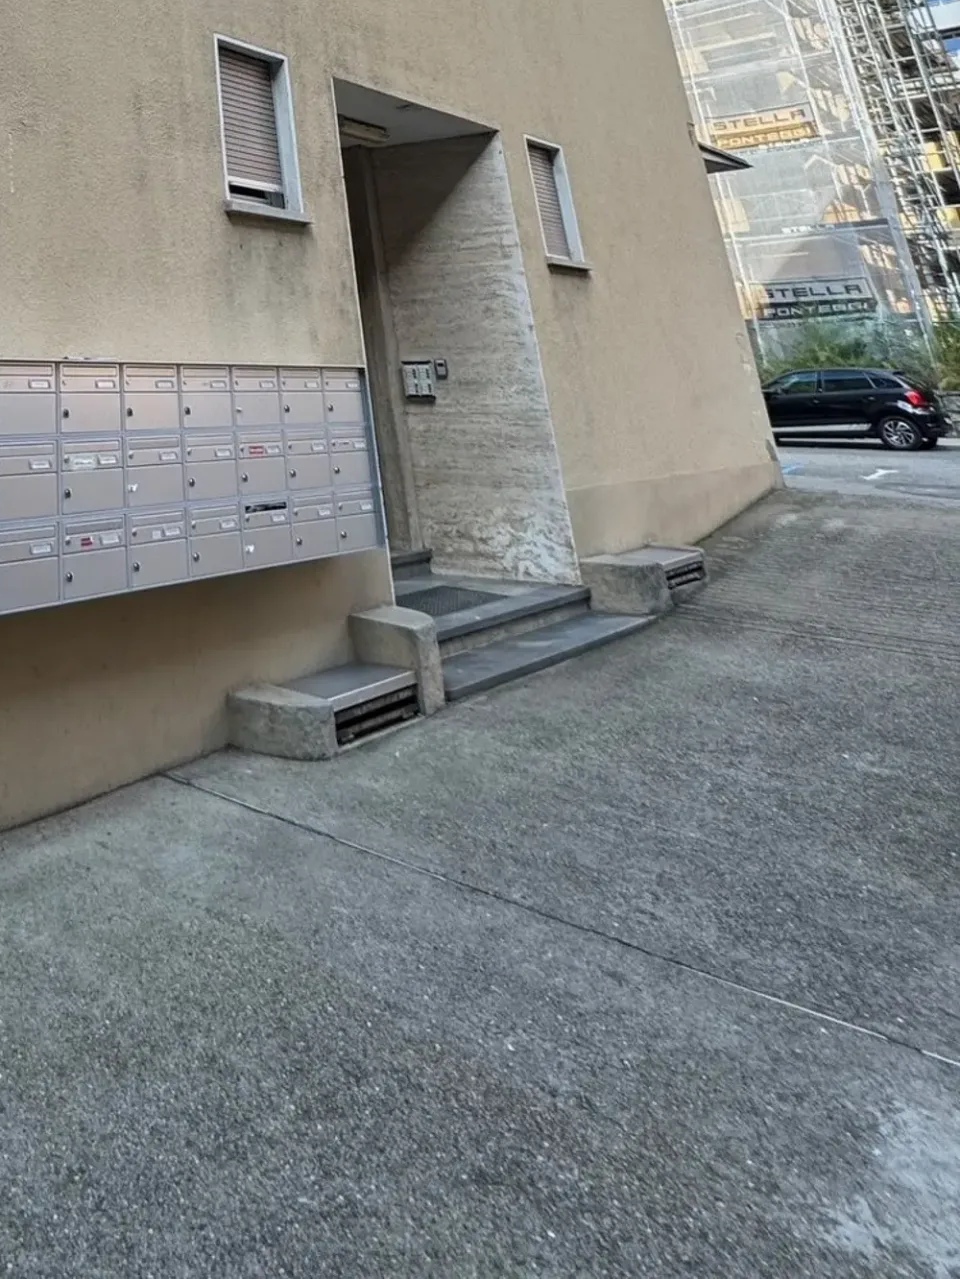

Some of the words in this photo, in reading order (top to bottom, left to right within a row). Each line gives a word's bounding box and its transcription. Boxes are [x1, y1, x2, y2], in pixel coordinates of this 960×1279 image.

[713, 108, 806, 131] STELLA
[762, 284, 863, 300] STELLA
[763, 302, 868, 318] PONTEGGI
